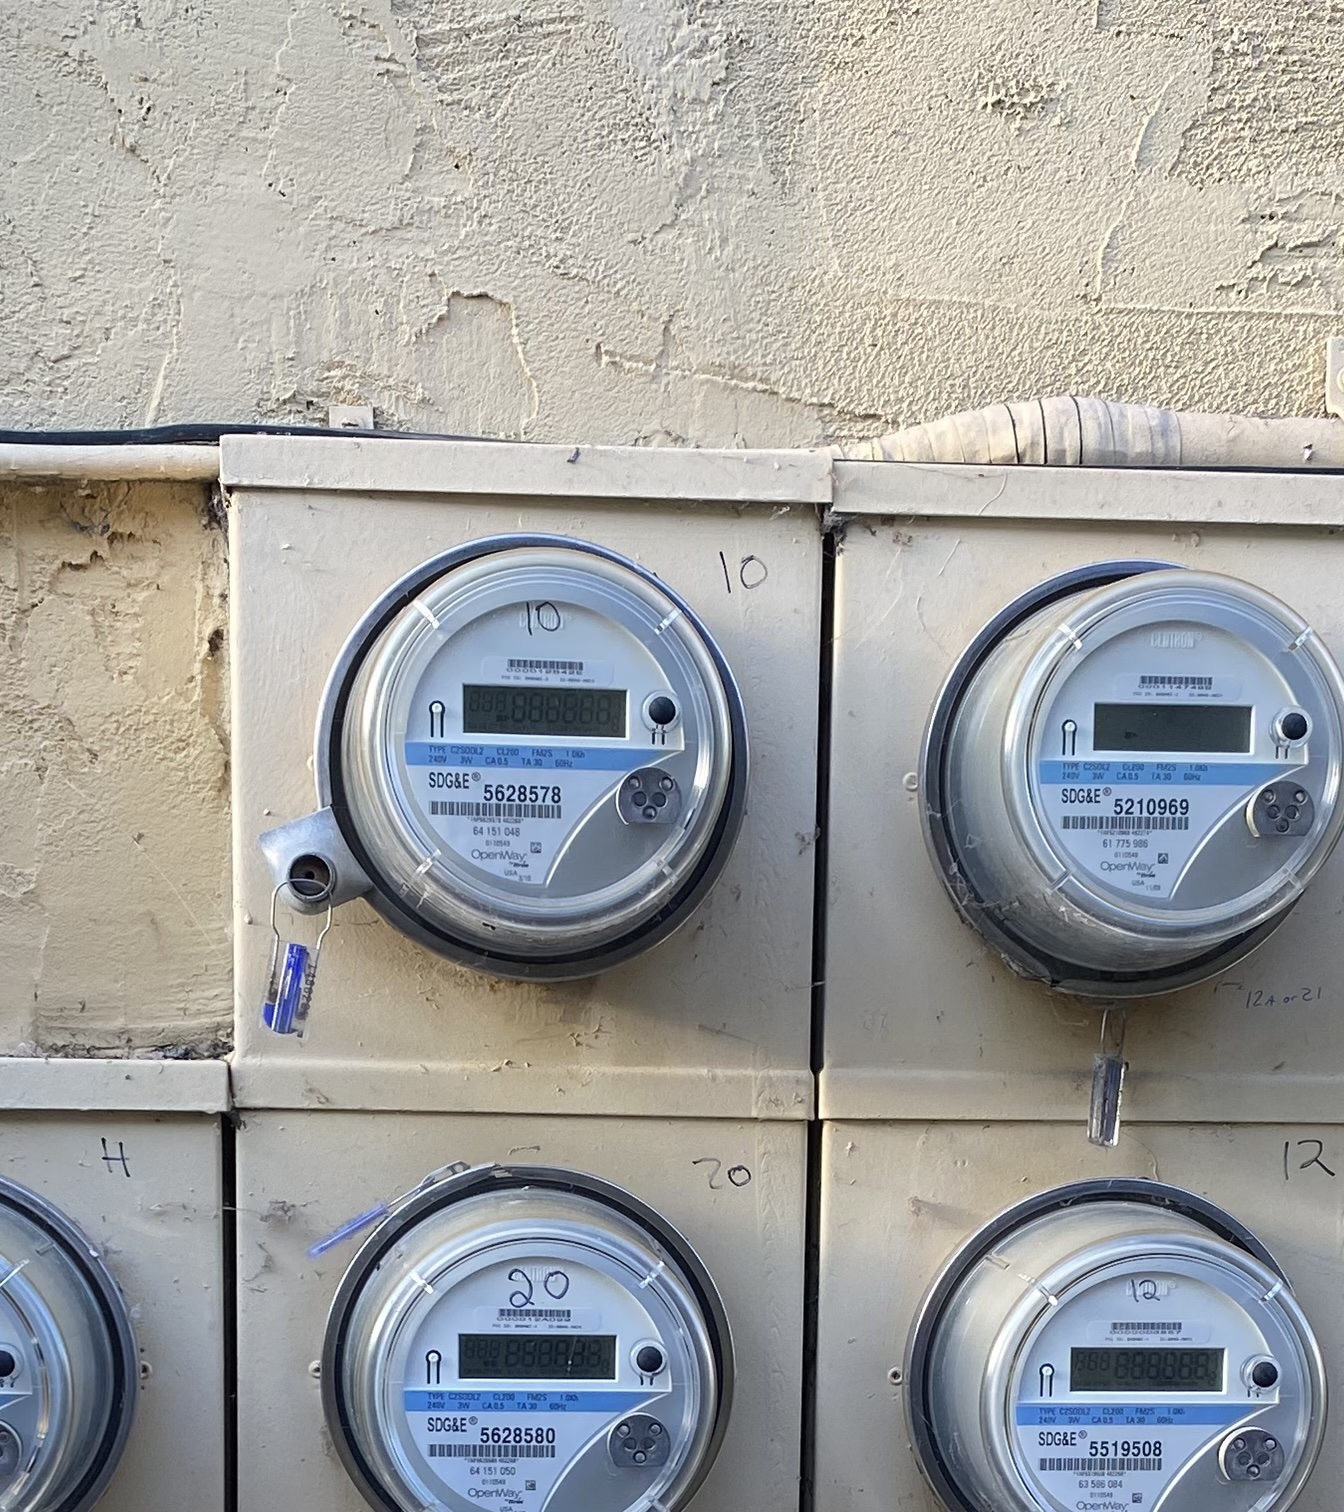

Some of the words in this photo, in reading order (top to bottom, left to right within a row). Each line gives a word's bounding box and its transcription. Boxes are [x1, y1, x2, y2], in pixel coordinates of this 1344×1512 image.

[719, 551, 768, 593] 10
[526, 601, 561, 635] 10
[483, 784, 562, 804] 5628578
[1113, 798, 1190, 816] 5210969
[473, 826, 484, 837] 64
[486, 826, 501, 837] 151
[1102, 838, 1114, 849] 61
[1116, 838, 1130, 849] 775
[471, 849, 527, 864] OpenWay
[1100, 861, 1154, 874] OpenWay
[1302, 987, 1322, 1002] 21
[1283, 1139, 1336, 1181] 12
[692, 1157, 752, 1190] 20
[508, 1268, 570, 1308] 20
[1130, 1279, 1161, 1303] 12
[480, 1427, 556, 1444] 5628580
[1089, 1440, 1163, 1458] 5519508
[467, 1488, 523, 1501] OpenWay
[1075, 1501, 1130, 1512] OpenWay
